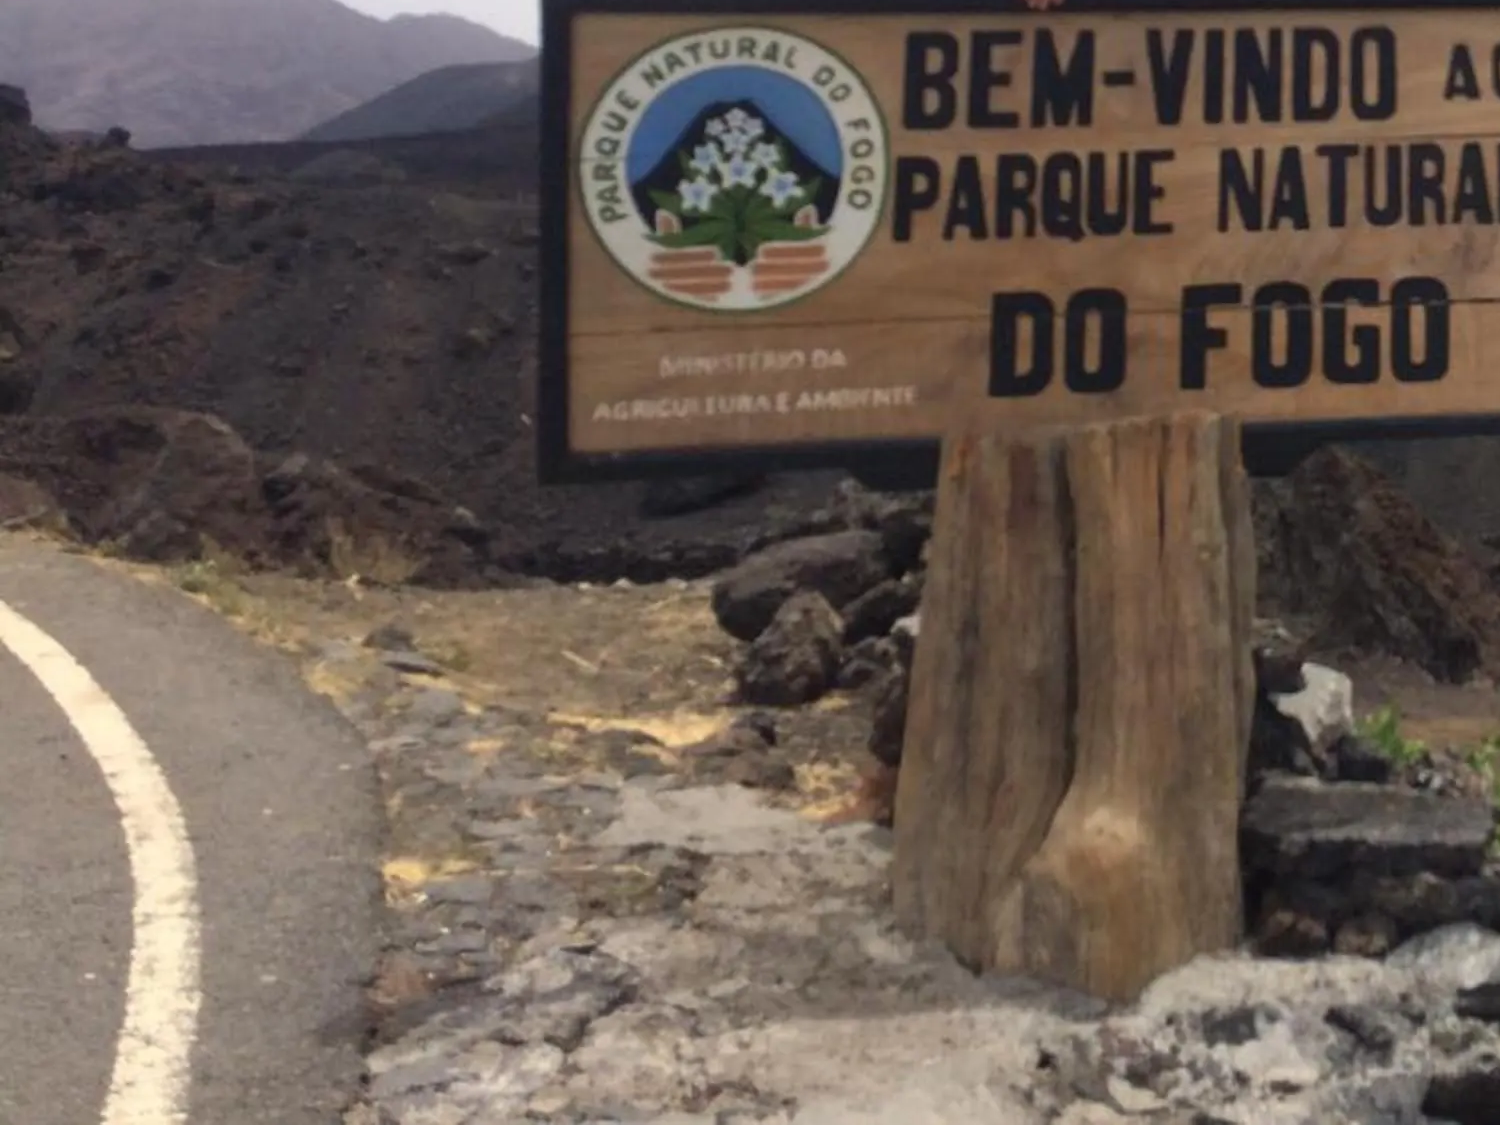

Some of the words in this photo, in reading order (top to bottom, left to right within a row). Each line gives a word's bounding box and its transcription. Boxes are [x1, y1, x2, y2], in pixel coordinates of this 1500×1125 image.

[592, 89, 640, 223] PARQUE
[640, 37, 799, 88] NATURAL
[812, 65, 852, 103] DO
[847, 118, 876, 211] FOGO
[903, 26, 1396, 130] BEM-VINDO
[893, 150, 1174, 242] PARQUE
[811, 348, 847, 369] DA
[988, 289, 1127, 398] DO
[1181, 277, 1450, 390] FOGO
